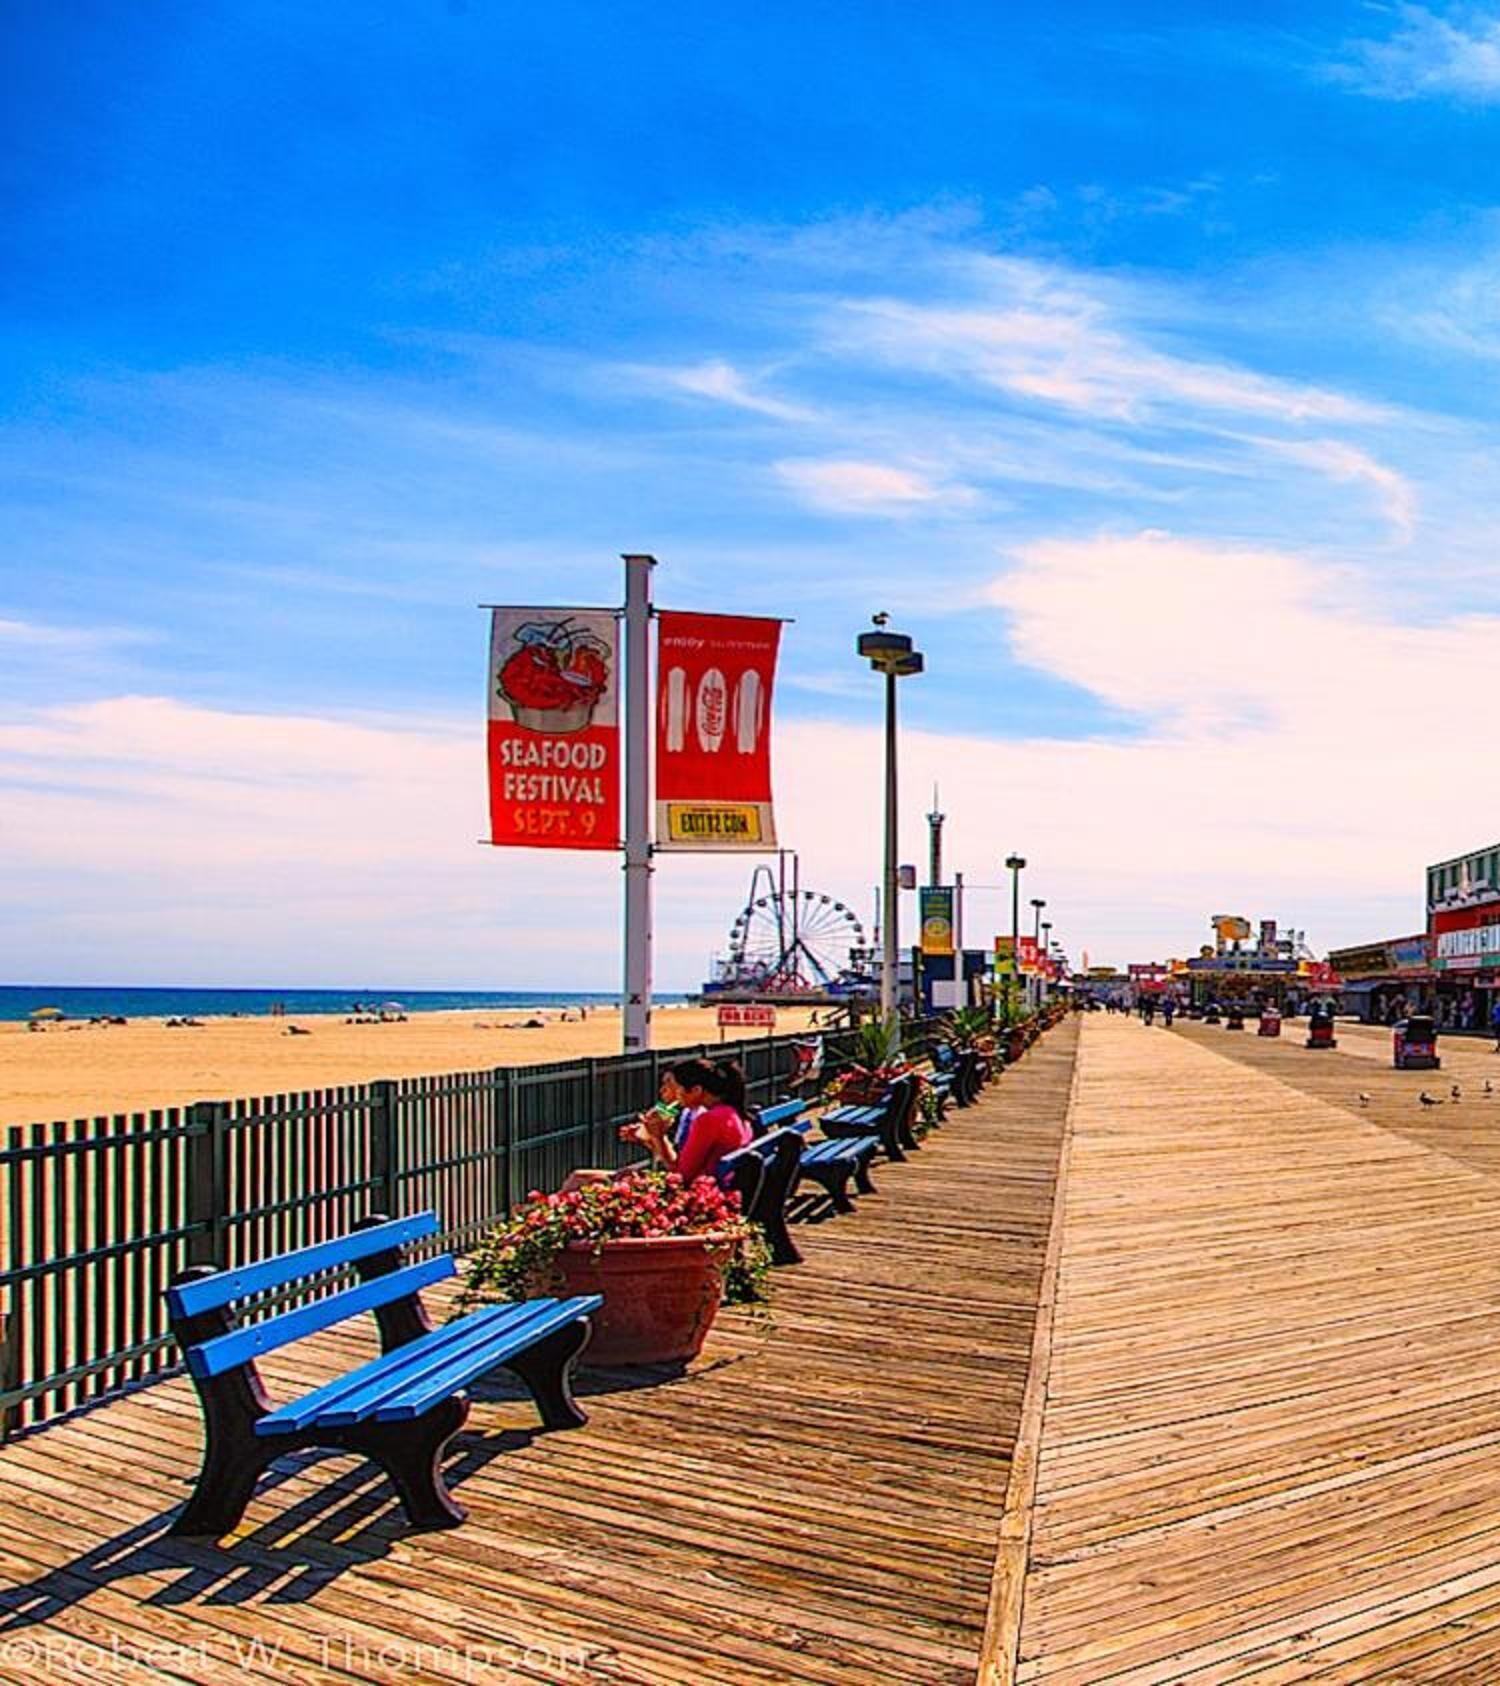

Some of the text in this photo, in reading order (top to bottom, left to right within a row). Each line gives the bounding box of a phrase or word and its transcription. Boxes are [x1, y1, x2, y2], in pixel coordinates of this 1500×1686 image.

[500, 738, 606, 770] SEAFOOD
[504, 773, 605, 804] FESTIVAL
[513, 808, 596, 835] SEPT. 9
